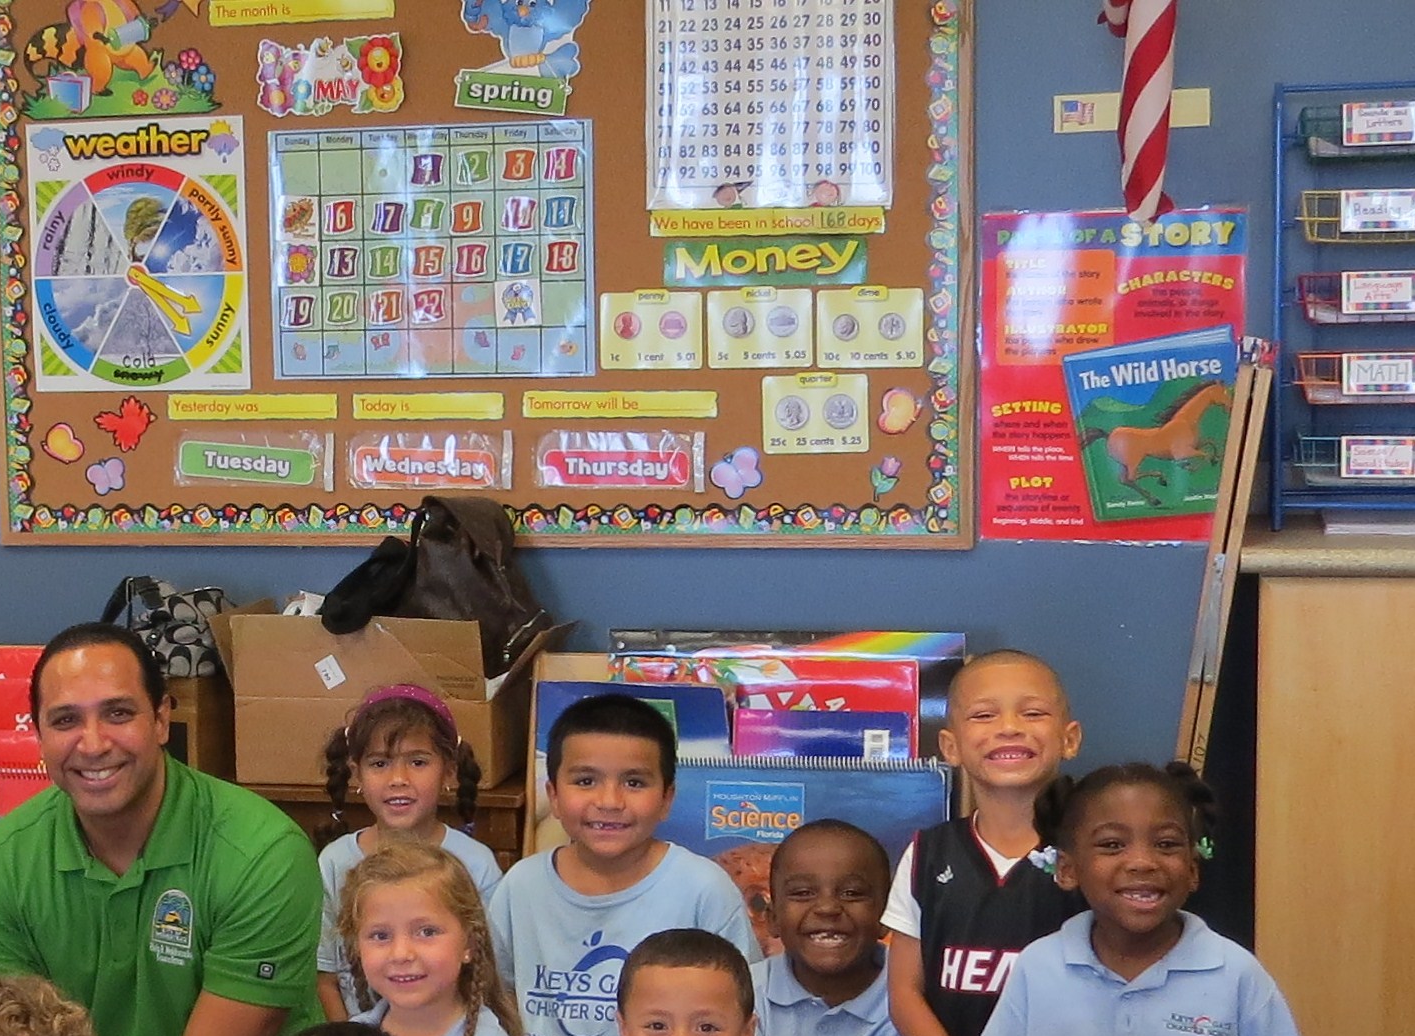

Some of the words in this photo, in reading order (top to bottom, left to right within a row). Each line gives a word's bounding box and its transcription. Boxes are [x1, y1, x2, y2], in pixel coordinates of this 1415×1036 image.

[216, 4, 237, 18] The
[239, 6, 277, 17] month
[281, 5, 291, 16] is
[725, 18, 741, 31] 24
[747, 17, 764, 30] 25
[864, 13, 881, 25] 30
[747, 38, 764, 50] 35
[724, 60, 741, 72] 44
[315, 79, 359, 100] MAY
[468, 79, 553, 108] spring
[747, 80, 764, 92] 55
[326, 135, 353, 145] Monday
[454, 131, 488, 141] Thursday
[504, 129, 527, 140] Friday
[724, 123, 740, 136] 74
[66, 124, 207, 159] weather
[107, 167, 155, 181] windy
[514, 153, 526, 179] 3
[724, 165, 740, 178] 94
[188, 188, 221, 223] partly
[219, 219, 237, 266] sunny
[336, 208, 346, 229] 6
[385, 206, 396, 228] 7
[463, 207, 473, 228] 9
[654, 216, 678, 230] We
[682, 218, 713, 230] have
[718, 217, 751, 230] been
[755, 216, 767, 228] in
[771, 214, 814, 229] school
[820, 211, 846, 228] 168
[42, 210, 66, 251] rainy
[1100, 229, 1116, 243] A
[1121, 221, 1235, 246] STORY
[334, 247, 356, 271] 13
[375, 247, 395, 271] 14
[419, 248, 439, 271] 15
[461, 246, 481, 270] 16
[553, 245, 573, 269] 18
[675, 240, 859, 279] Money
[1117, 270, 1235, 294] CHARACTERS
[333, 293, 351, 318] 20
[43, 302, 74, 351] cloudy
[205, 302, 236, 348] sunny
[122, 352, 157, 369] Cold
[864, 352, 888, 360] cents
[1079, 370, 1111, 390] The
[1111, 362, 1158, 385] Wild
[1161, 357, 1223, 379] Horse
[1357, 362, 1409, 382] MATH
[174, 400, 231, 414] Yesterday
[235, 402, 259, 412] was
[360, 399, 397, 414] Today
[399, 400, 410, 412] is
[528, 396, 594, 411] Tomorrow
[597, 398, 618, 410] will
[621, 398, 639, 410] be
[991, 401, 1062, 417] SETTING
[810, 438, 834, 446] cents
[203, 451, 291, 477] Tuesday
[365, 455, 485, 479] Wednesday
[565, 457, 669, 480] Thursday
[1009, 476, 1053, 489] PLOT
[711, 806, 800, 829] Science
[756, 830, 784, 838] Florida
[535, 965, 592, 993] KEYS
[941, 946, 1021, 993] HEA
